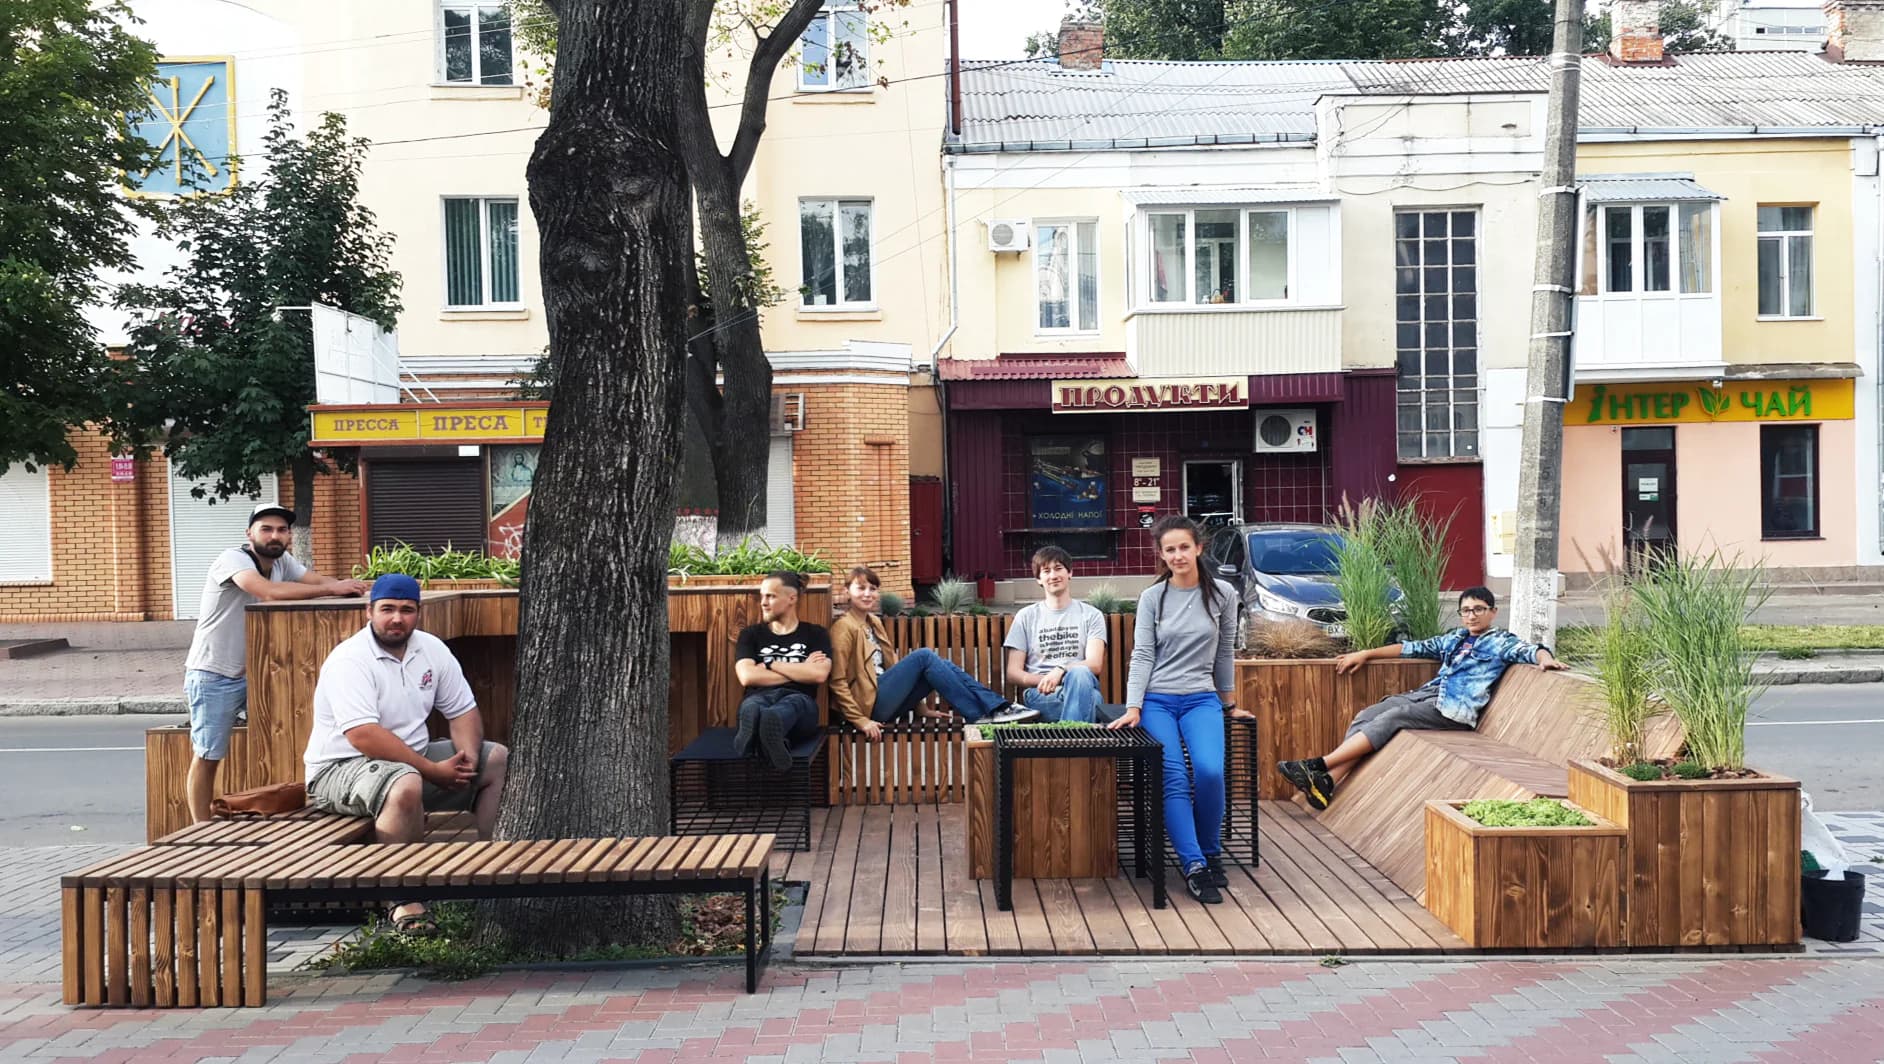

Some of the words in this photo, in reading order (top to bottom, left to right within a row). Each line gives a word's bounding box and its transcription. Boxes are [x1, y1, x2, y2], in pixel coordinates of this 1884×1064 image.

[1059, 382, 1241, 407] ПРОДУКТИ
[1740, 385, 1811, 417] ЧАЙ
[333, 418, 400, 432] ПРЕССА
[432, 415, 509, 431] ПРЕСА
[1038, 511, 1073, 519] ХОЛОДНІ
[1078, 510, 1103, 519] НАПОЇ
